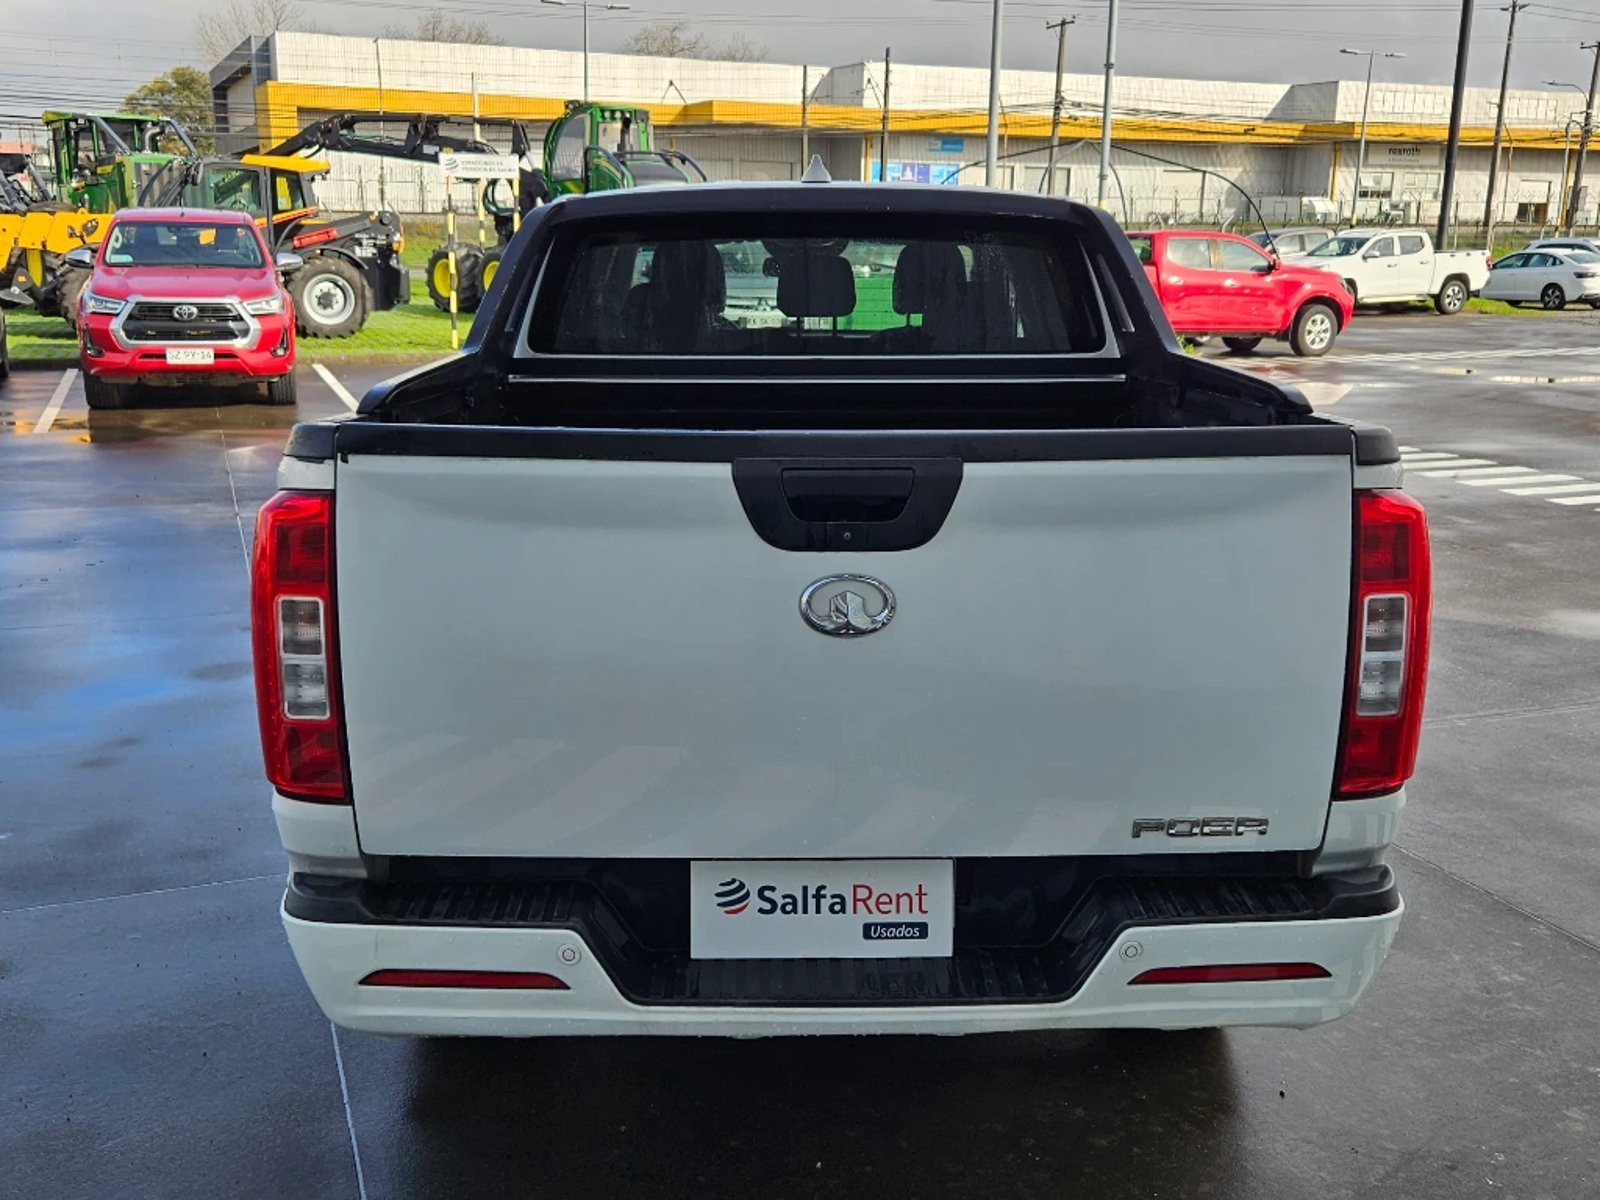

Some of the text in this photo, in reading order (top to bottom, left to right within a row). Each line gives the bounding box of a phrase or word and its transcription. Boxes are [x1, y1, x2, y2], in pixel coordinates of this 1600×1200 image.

[1132, 817, 1269, 838] POER
[757, 884, 929, 915] SalfaRent
[870, 925, 920, 938] Usados
